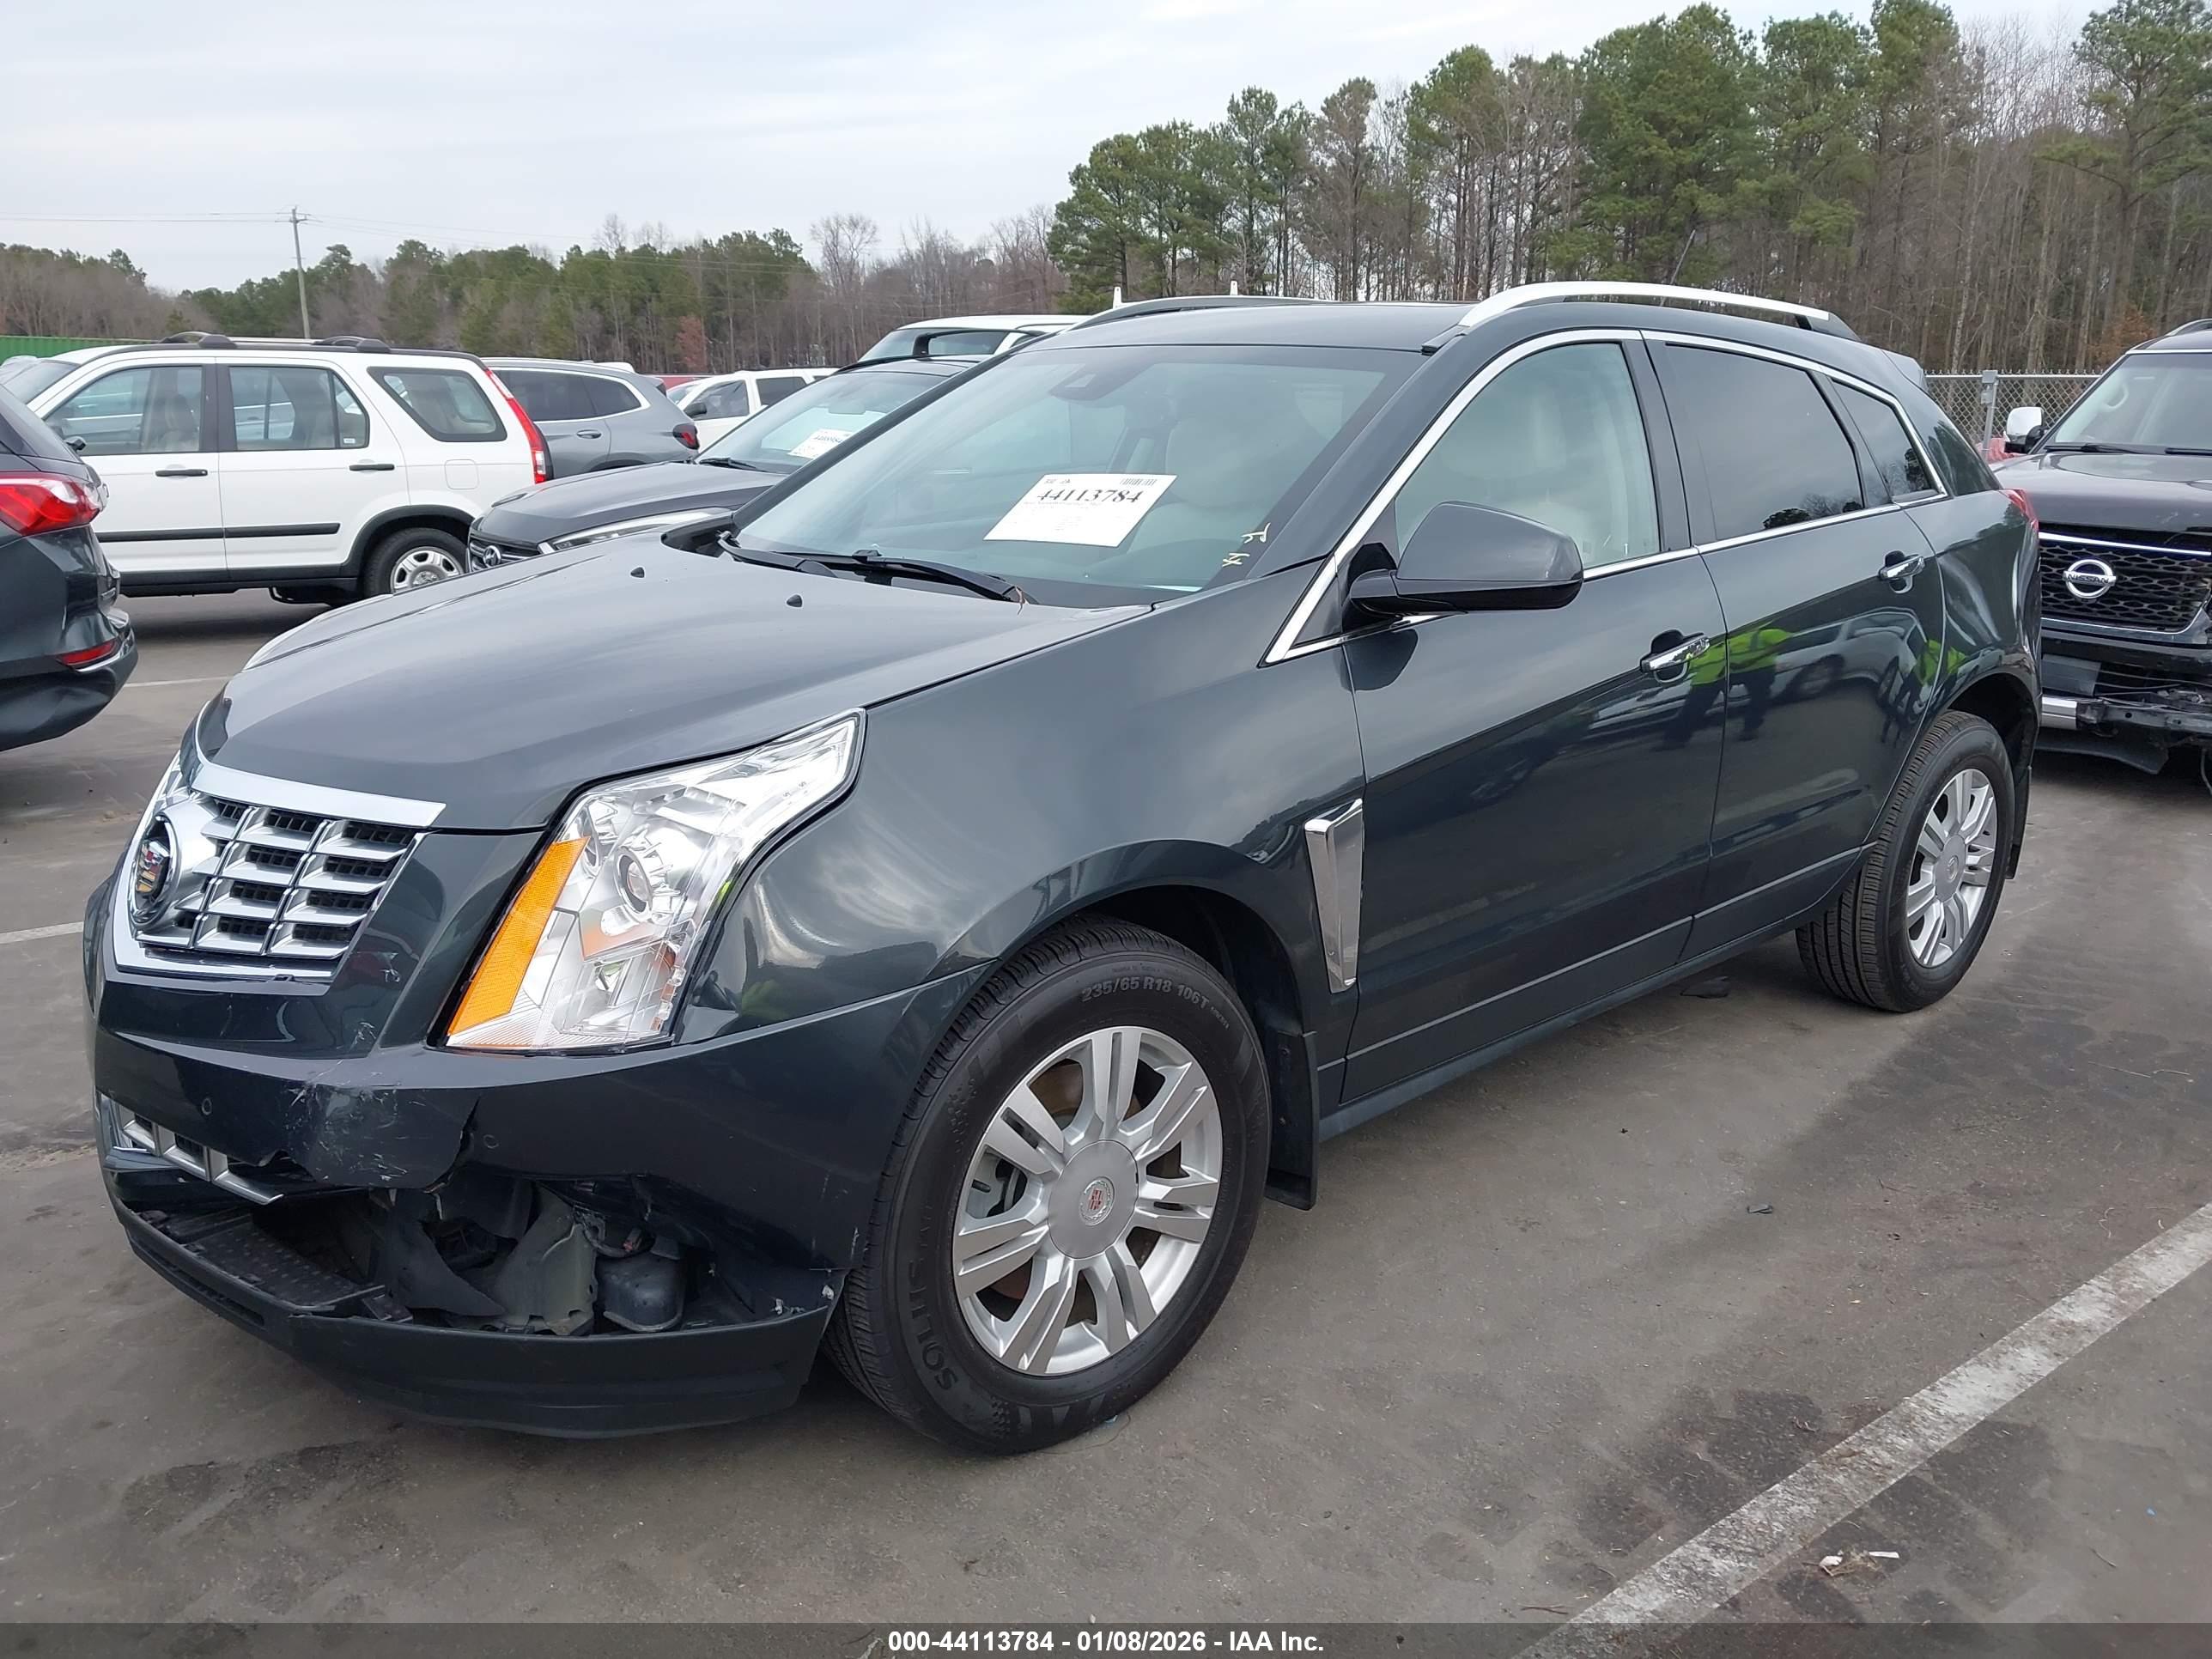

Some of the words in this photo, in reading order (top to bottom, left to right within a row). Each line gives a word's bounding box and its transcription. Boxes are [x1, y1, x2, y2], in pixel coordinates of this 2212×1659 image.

[1036, 489, 1144, 503] 44113784
[2067, 574, 2110, 584] NISSAN
[1080, 975, 1140, 1003] 235/65
[1143, 975, 1173, 993] R18
[1176, 984, 1210, 1009] 106T
